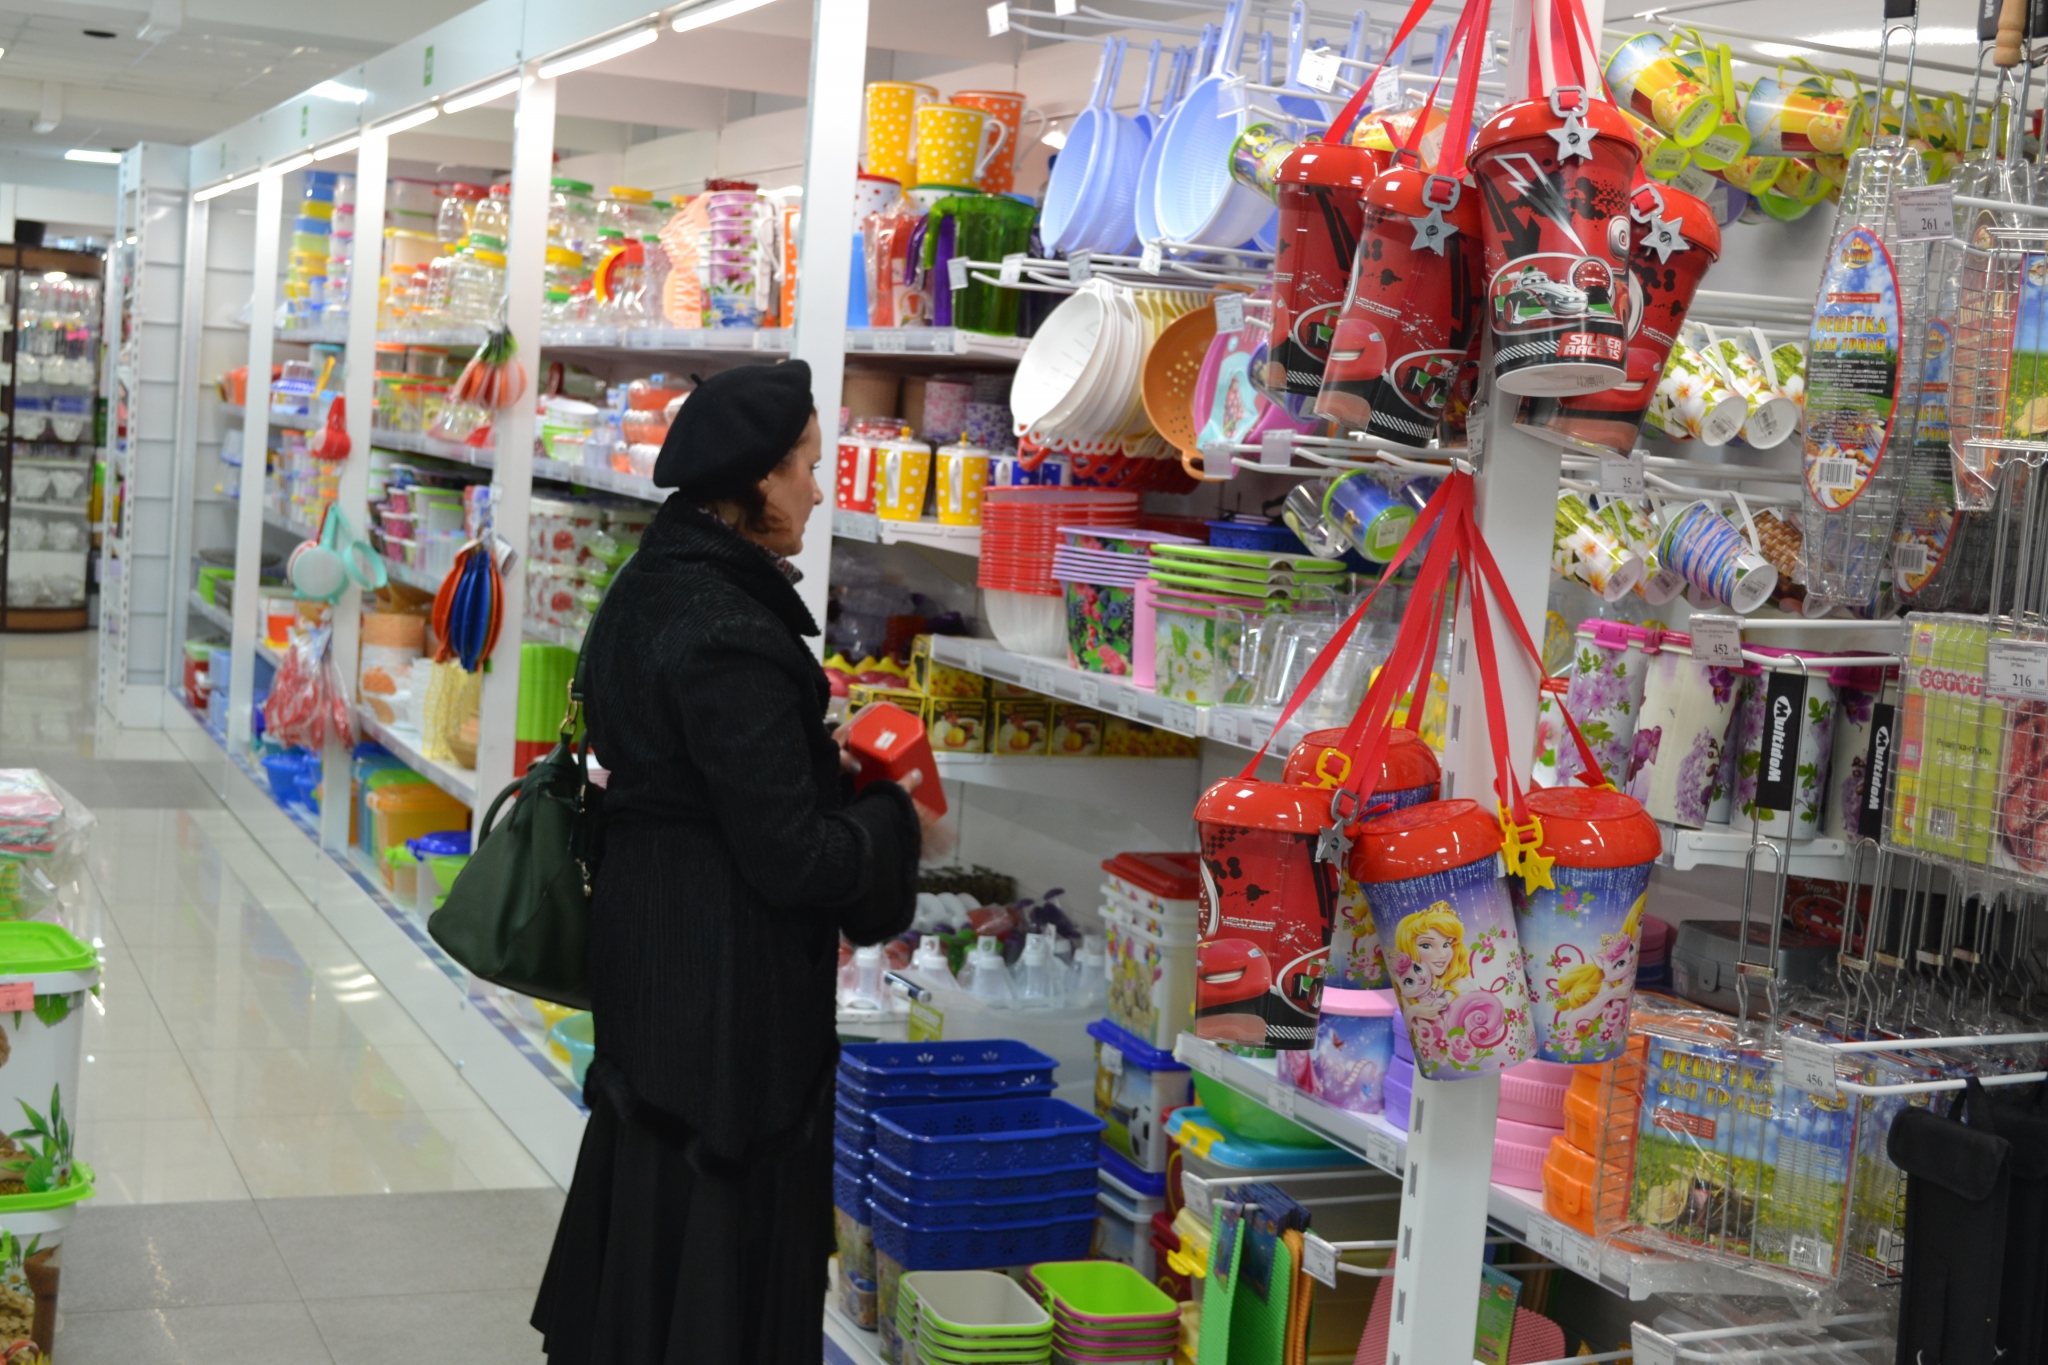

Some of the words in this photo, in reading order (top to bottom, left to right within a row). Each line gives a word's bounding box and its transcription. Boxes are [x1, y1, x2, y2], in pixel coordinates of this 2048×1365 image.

[1921, 218, 1938, 230] 261
[1816, 315, 1888, 334] РЕШЕТКА
[1569, 334, 1622, 351] SILVER
[1813, 337, 1838, 352] ДЛЯ
[1841, 337, 1886, 353] ГРИЛЯ
[1563, 345, 1621, 360] RACERS
[1713, 643, 1729, 656] 452
[2012, 673, 2032, 688] 216
[1661, 1049, 1775, 1096] РЕШЕТКА
[1806, 1073, 1823, 1087] 456
[1658, 1077, 1698, 1100] ДЛЯ
